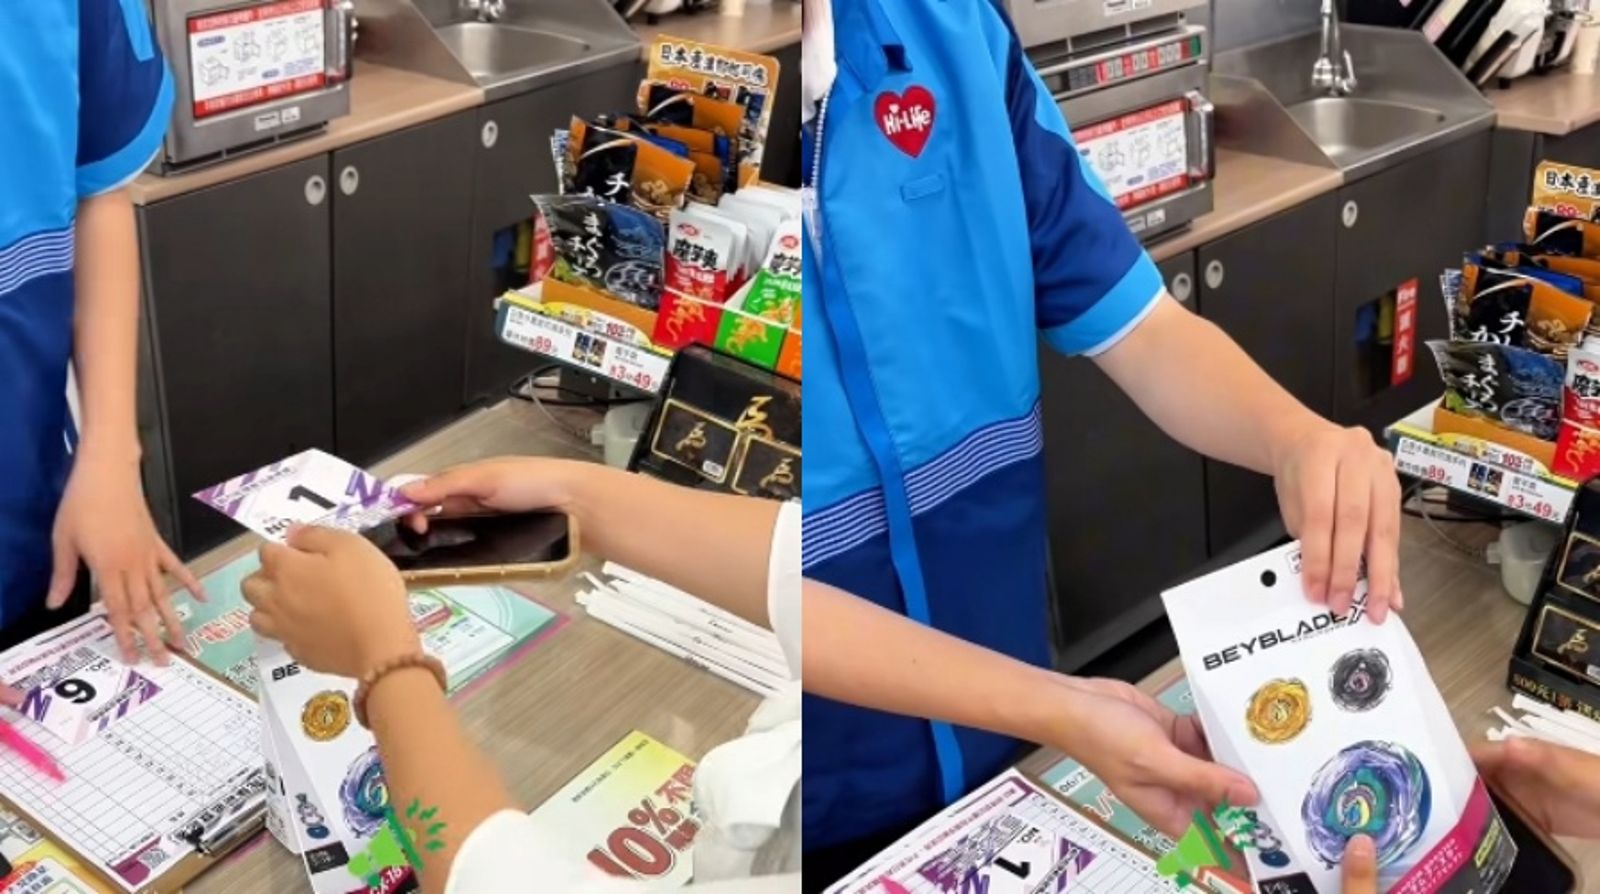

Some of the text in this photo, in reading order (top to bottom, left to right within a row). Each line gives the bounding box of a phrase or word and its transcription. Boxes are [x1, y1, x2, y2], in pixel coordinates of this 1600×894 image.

[883, 104, 931, 135] Hi-Life
[289, 484, 337, 511] 1
[993, 855, 1031, 880] 1
